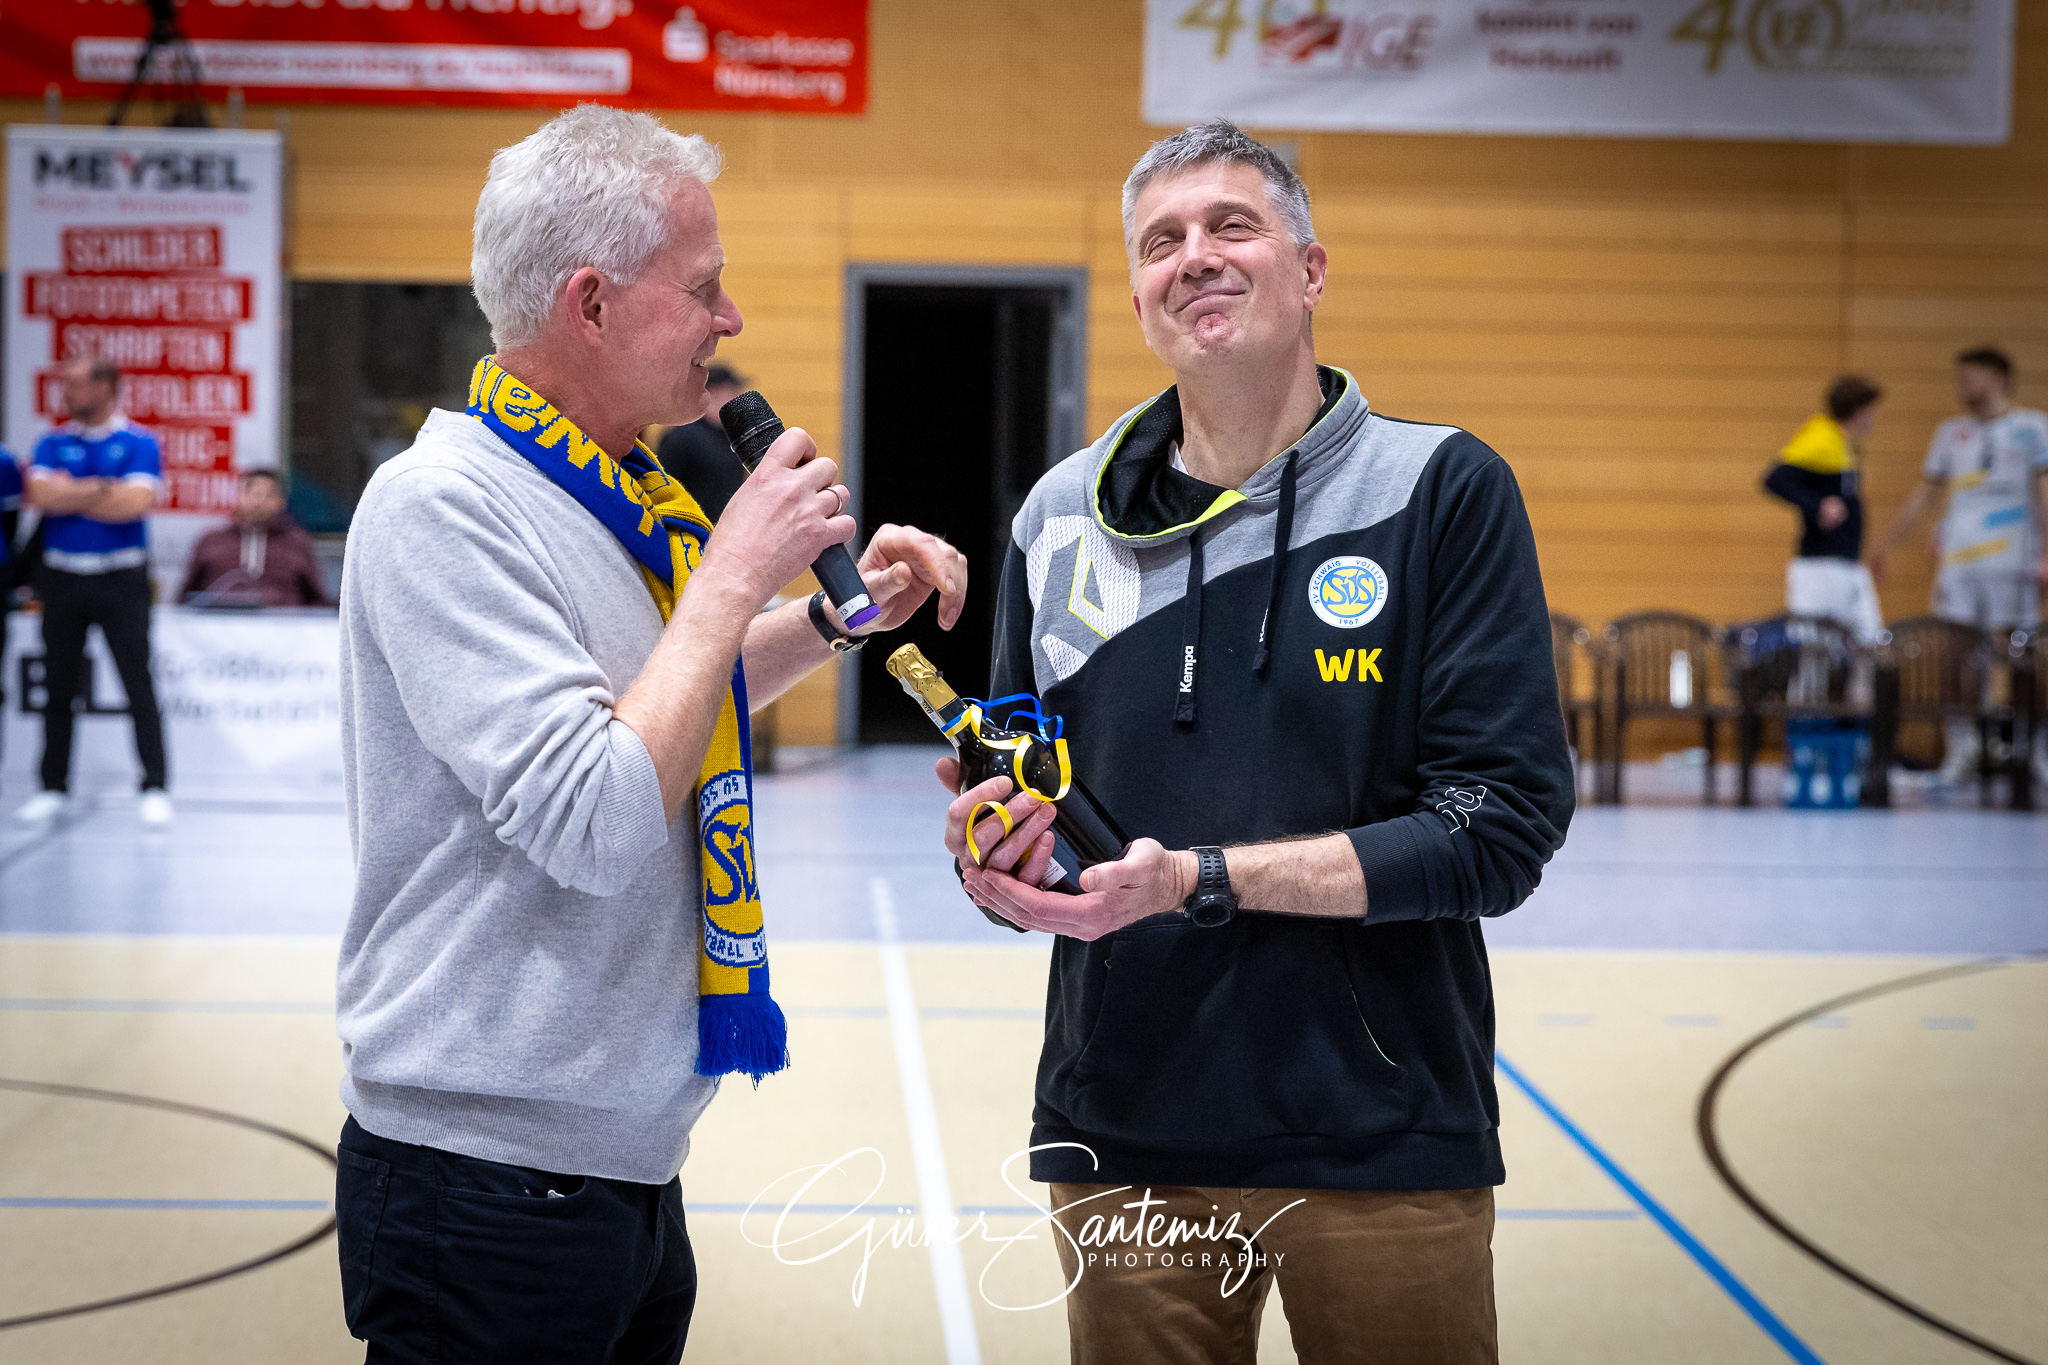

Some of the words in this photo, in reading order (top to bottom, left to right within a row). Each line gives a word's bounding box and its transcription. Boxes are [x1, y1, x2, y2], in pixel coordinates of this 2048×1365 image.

[713, 31, 854, 66] Sparkasse
[713, 64, 847, 106] Nürnberg
[34, 147, 252, 194] MEYSEL
[70, 232, 211, 271] SCHILDER
[35, 278, 238, 320] FOTOTAPETEN
[62, 325, 222, 370] SCHRIFTEN
[1312, 560, 1341, 591] SCHWAIG
[1355, 559, 1385, 601] VOLLEYBALL
[1312, 593, 1321, 604] SV
[1339, 618, 1359, 626] 1967
[1179, 645, 1197, 693] Kempa
[1314, 648, 1383, 682] WK
